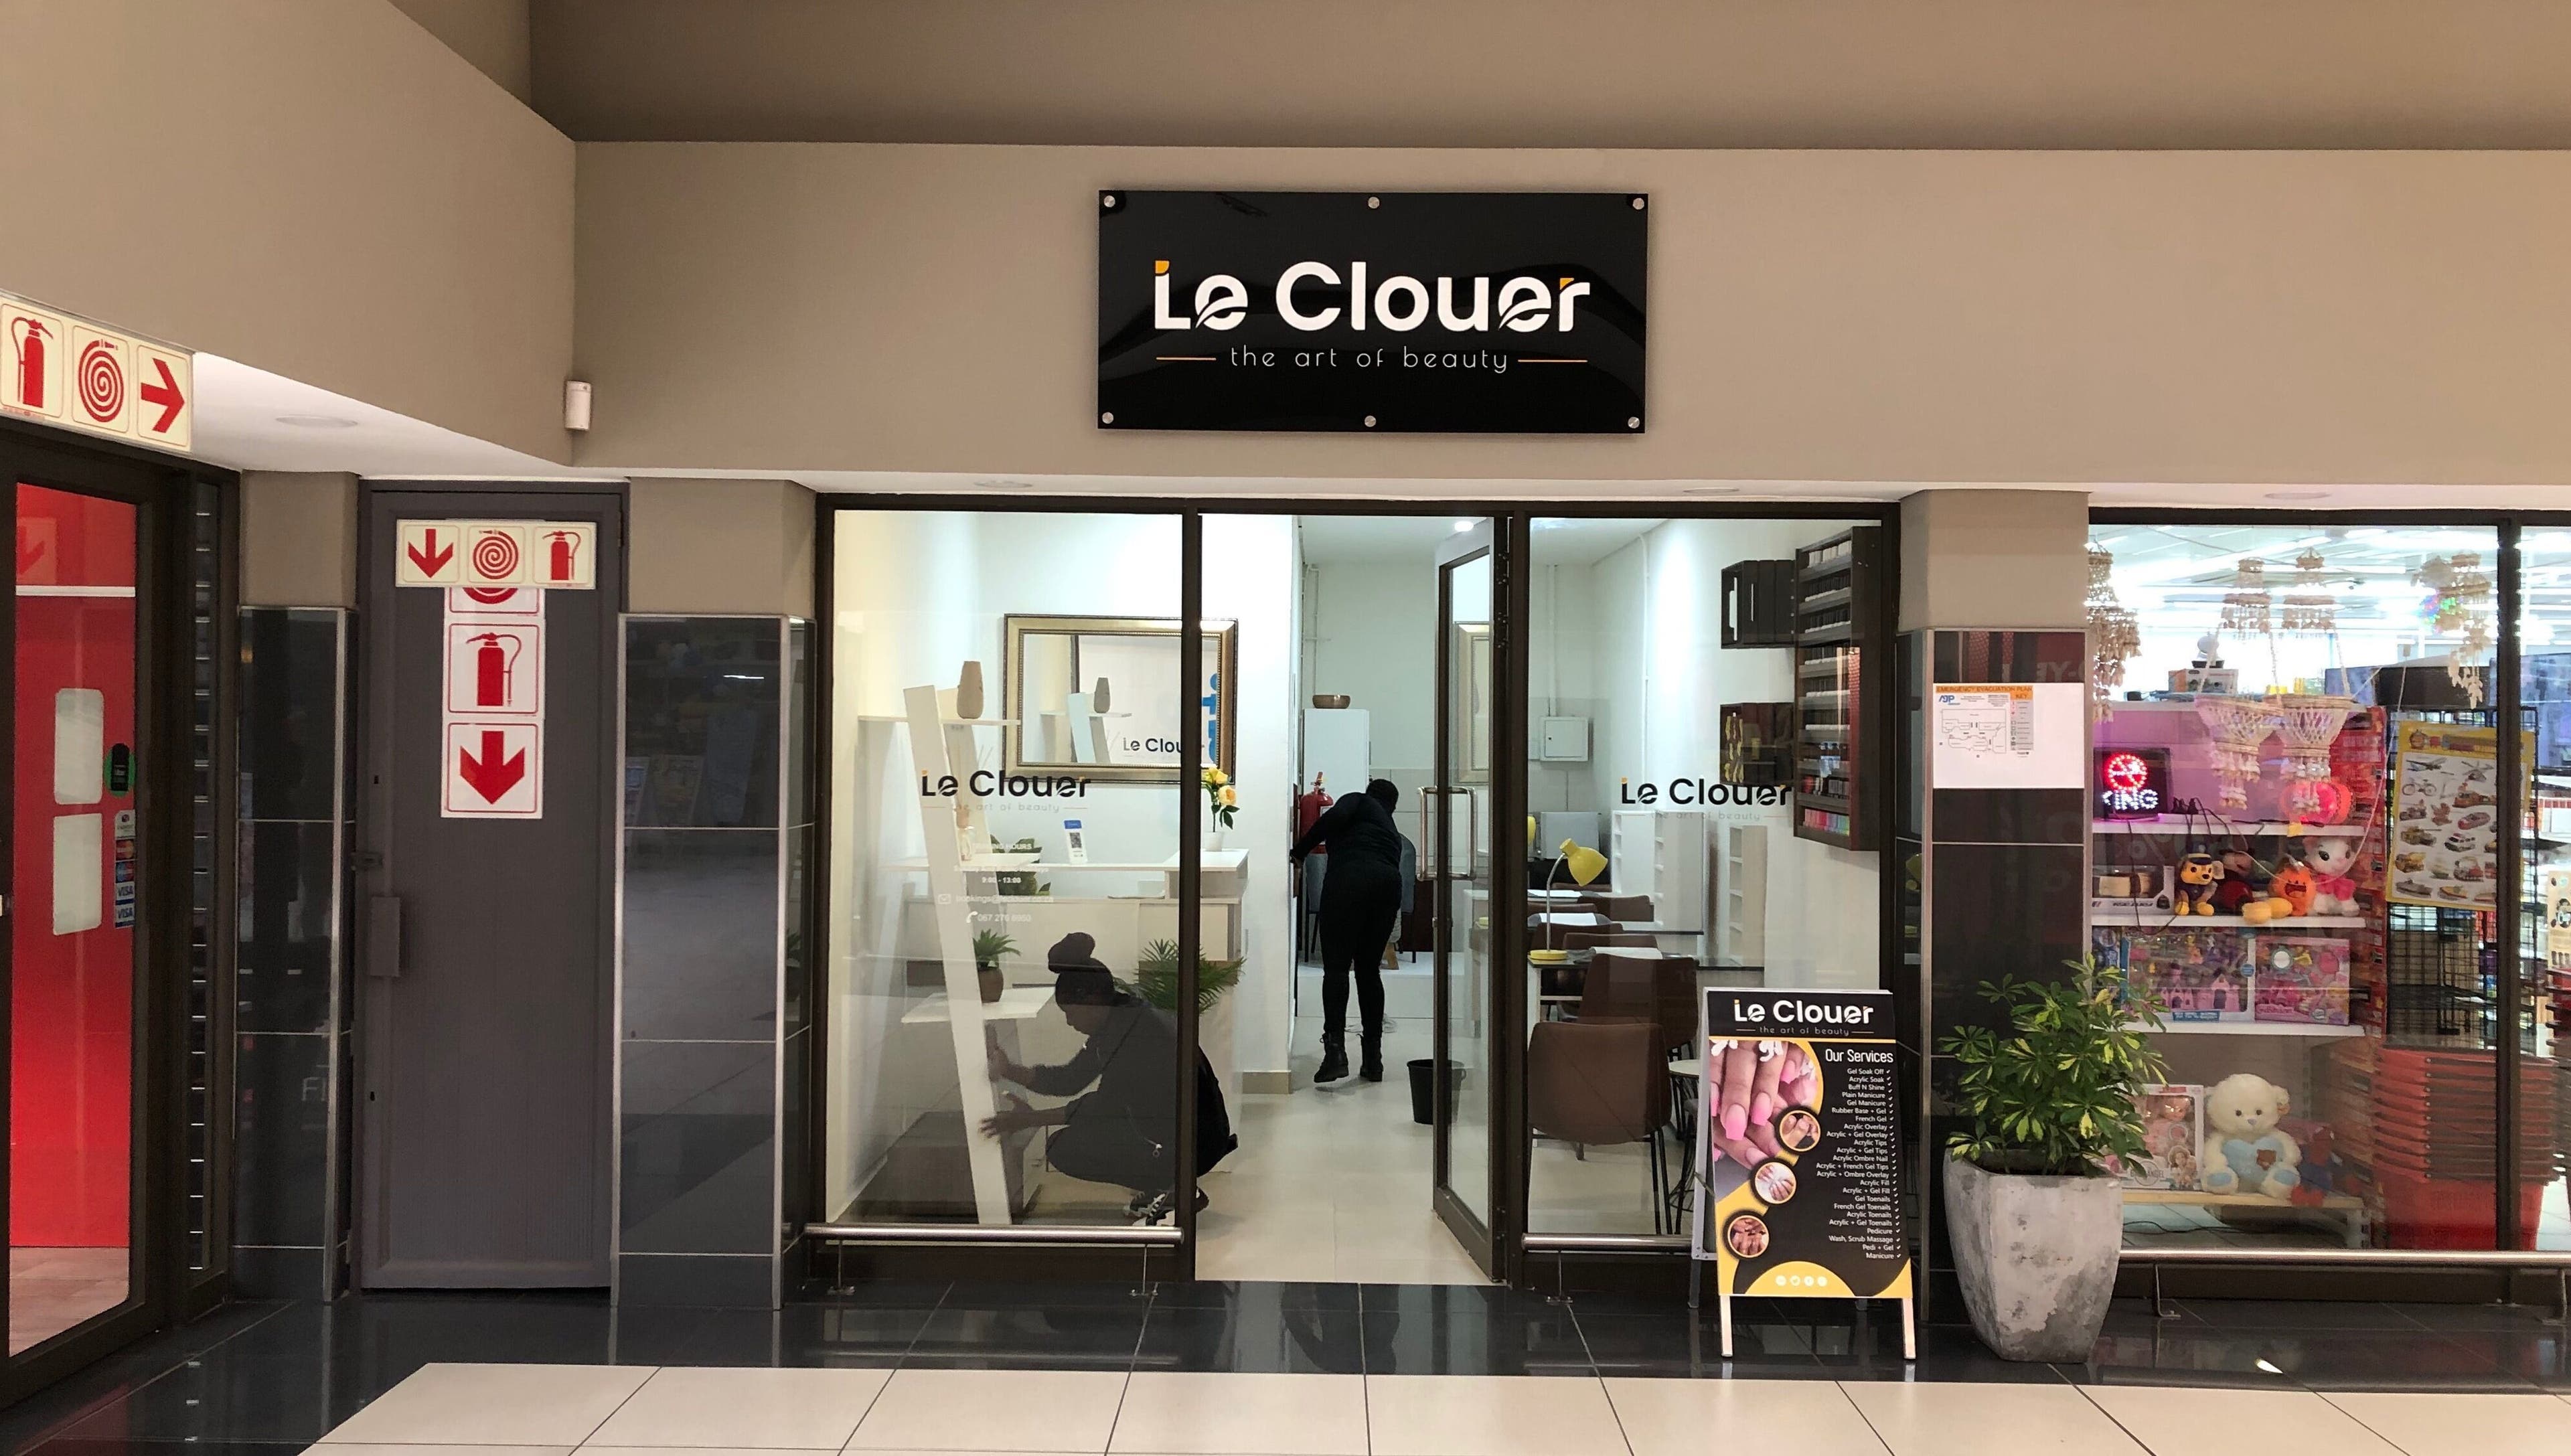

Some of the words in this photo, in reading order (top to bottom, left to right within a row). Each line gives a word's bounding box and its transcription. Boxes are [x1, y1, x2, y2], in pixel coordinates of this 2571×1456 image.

[1154, 260, 1248, 331] Le
[1275, 261, 1590, 332] Clouer
[1231, 345, 1275, 367] the
[1295, 349, 1338, 368] art
[1357, 349, 1384, 368] of
[1403, 347, 1507, 374] beauty
[1123, 737, 1140, 751] Le
[922, 770, 958, 797] Le
[969, 770, 1091, 798] Clouer
[1621, 777, 1658, 805] Le
[1669, 778, 1792, 805] Clouer
[1018, 803, 1060, 813] beauty
[1719, 811, 1760, 821] beauty
[1733, 999, 1764, 1022] Le
[1773, 999, 1873, 1024] Clouer
[1760, 1026, 1776, 1034] the
[1814, 1027, 1850, 1036] beauty
[1825, 1049, 1844, 1062] Our
[1847, 1050, 1893, 1062] Services
